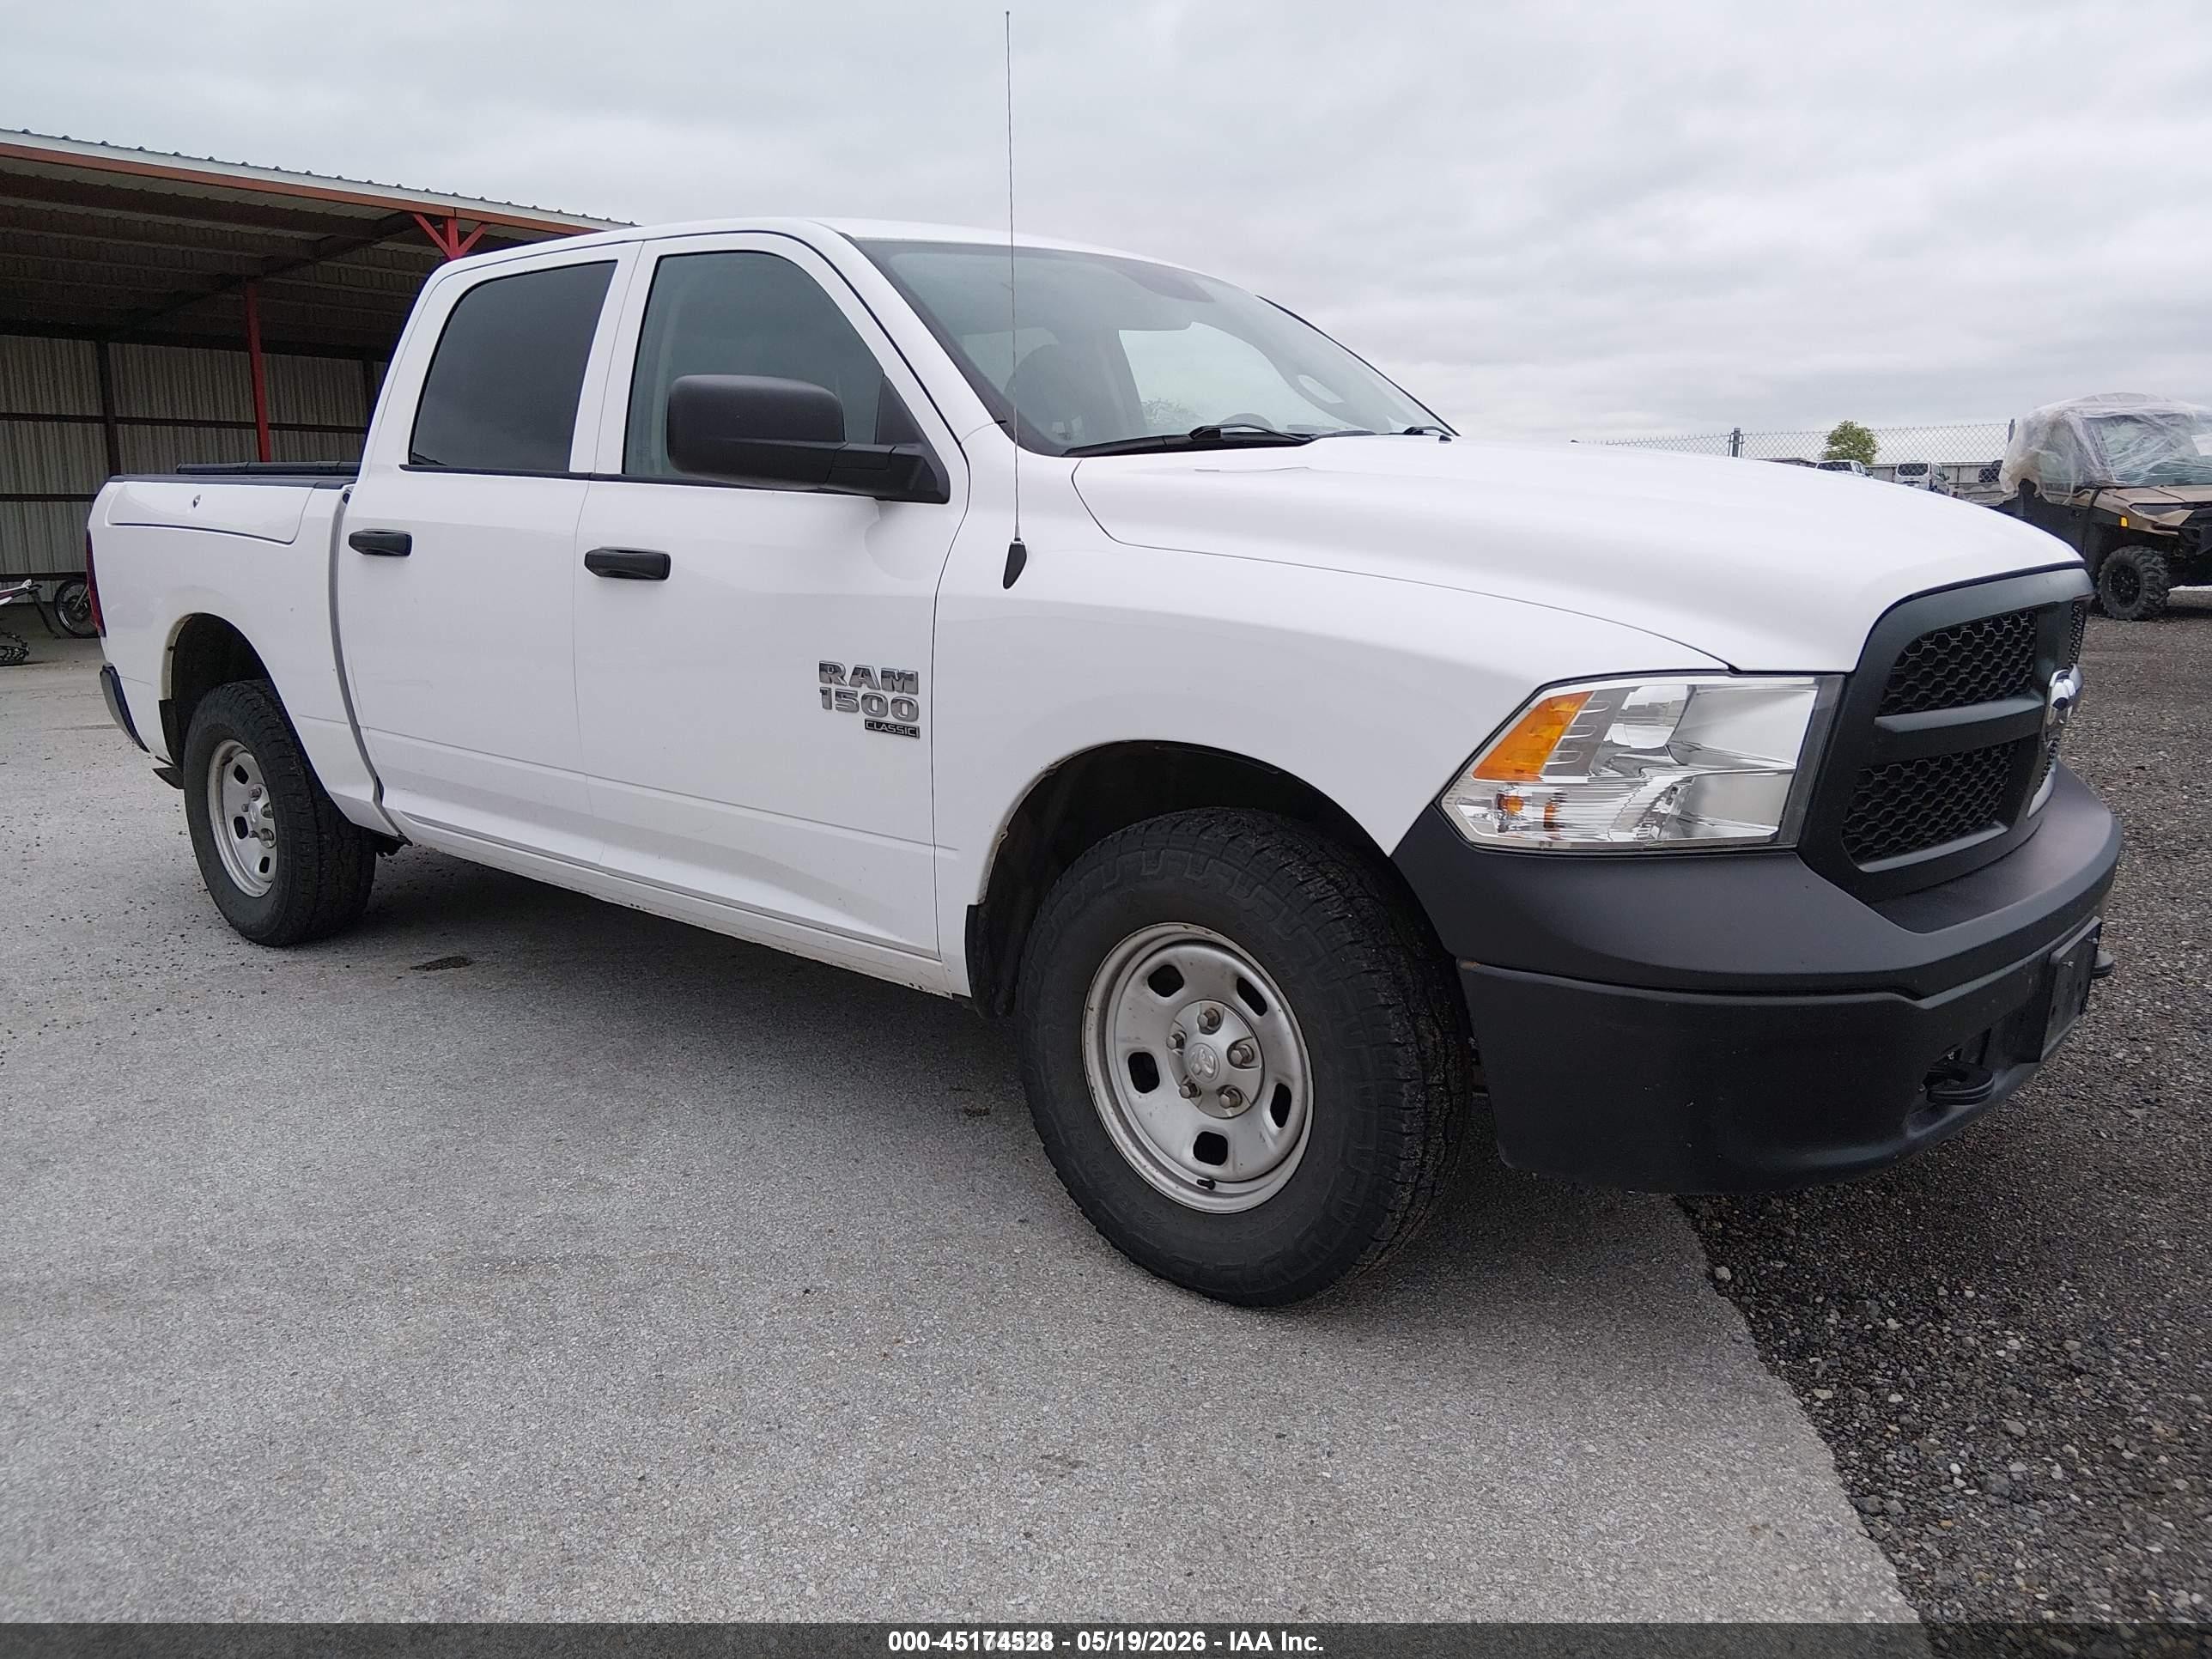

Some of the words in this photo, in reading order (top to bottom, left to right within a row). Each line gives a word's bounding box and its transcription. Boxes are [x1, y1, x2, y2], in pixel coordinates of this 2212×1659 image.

[818, 660, 919, 695] RAM
[819, 686, 919, 722] 1500
[865, 719, 918, 738] CLASSIC
